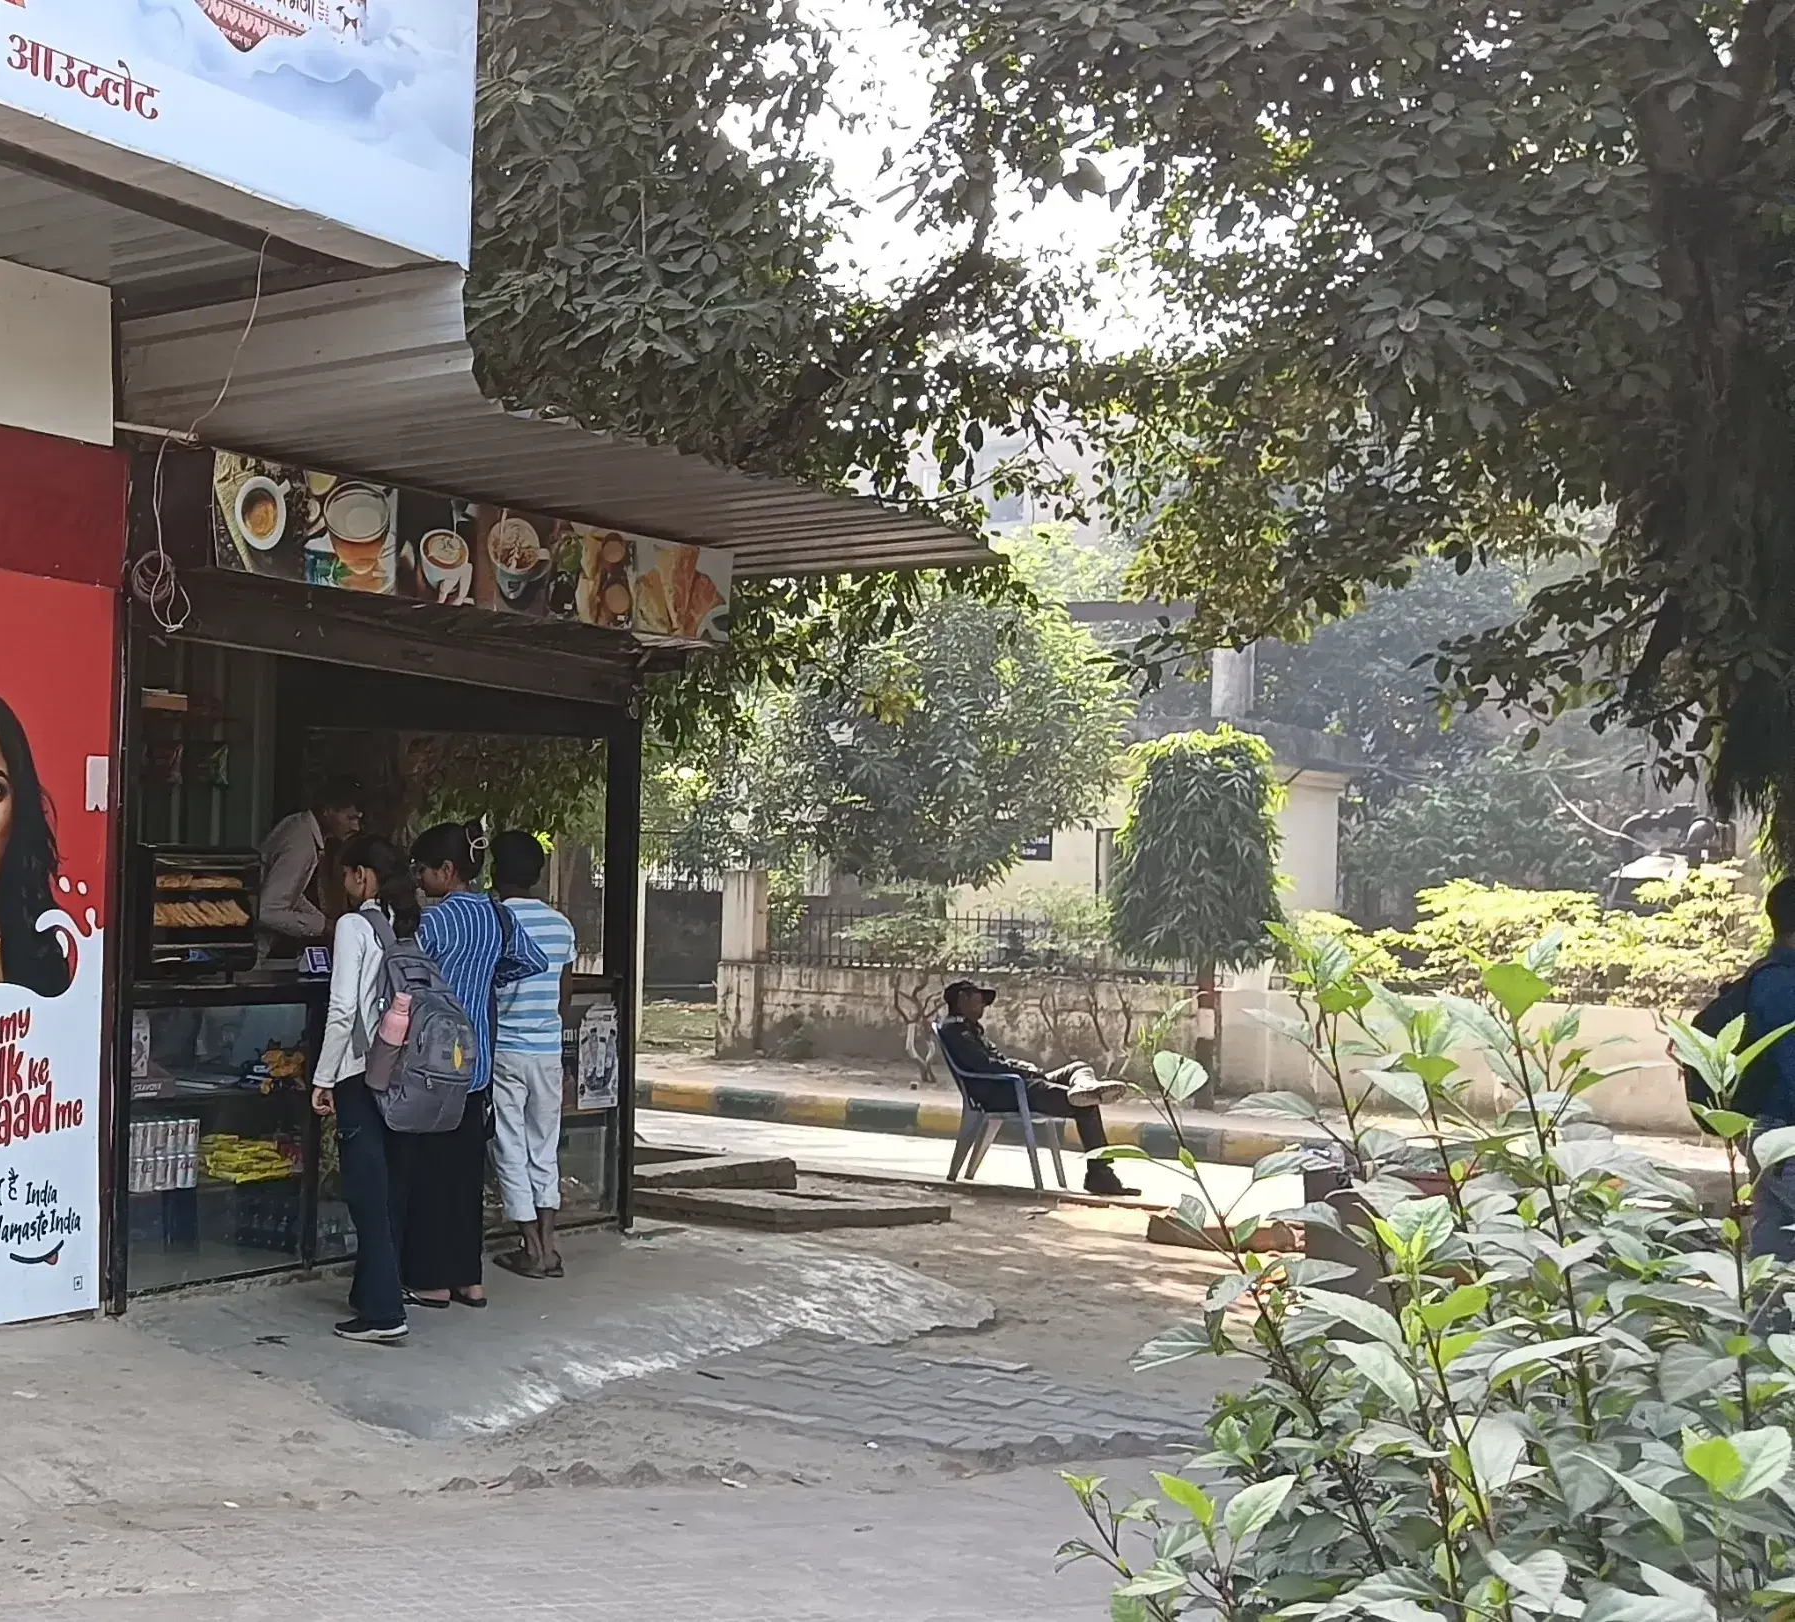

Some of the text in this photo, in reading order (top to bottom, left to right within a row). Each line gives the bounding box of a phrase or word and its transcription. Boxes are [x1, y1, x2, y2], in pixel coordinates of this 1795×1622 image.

[6, 33, 160, 120] आउटलेट
[28, 1057, 49, 1090] ke
[55, 1099, 83, 1131] me
[25, 1180, 58, 1205] India
[50, 1207, 81, 1234] India
